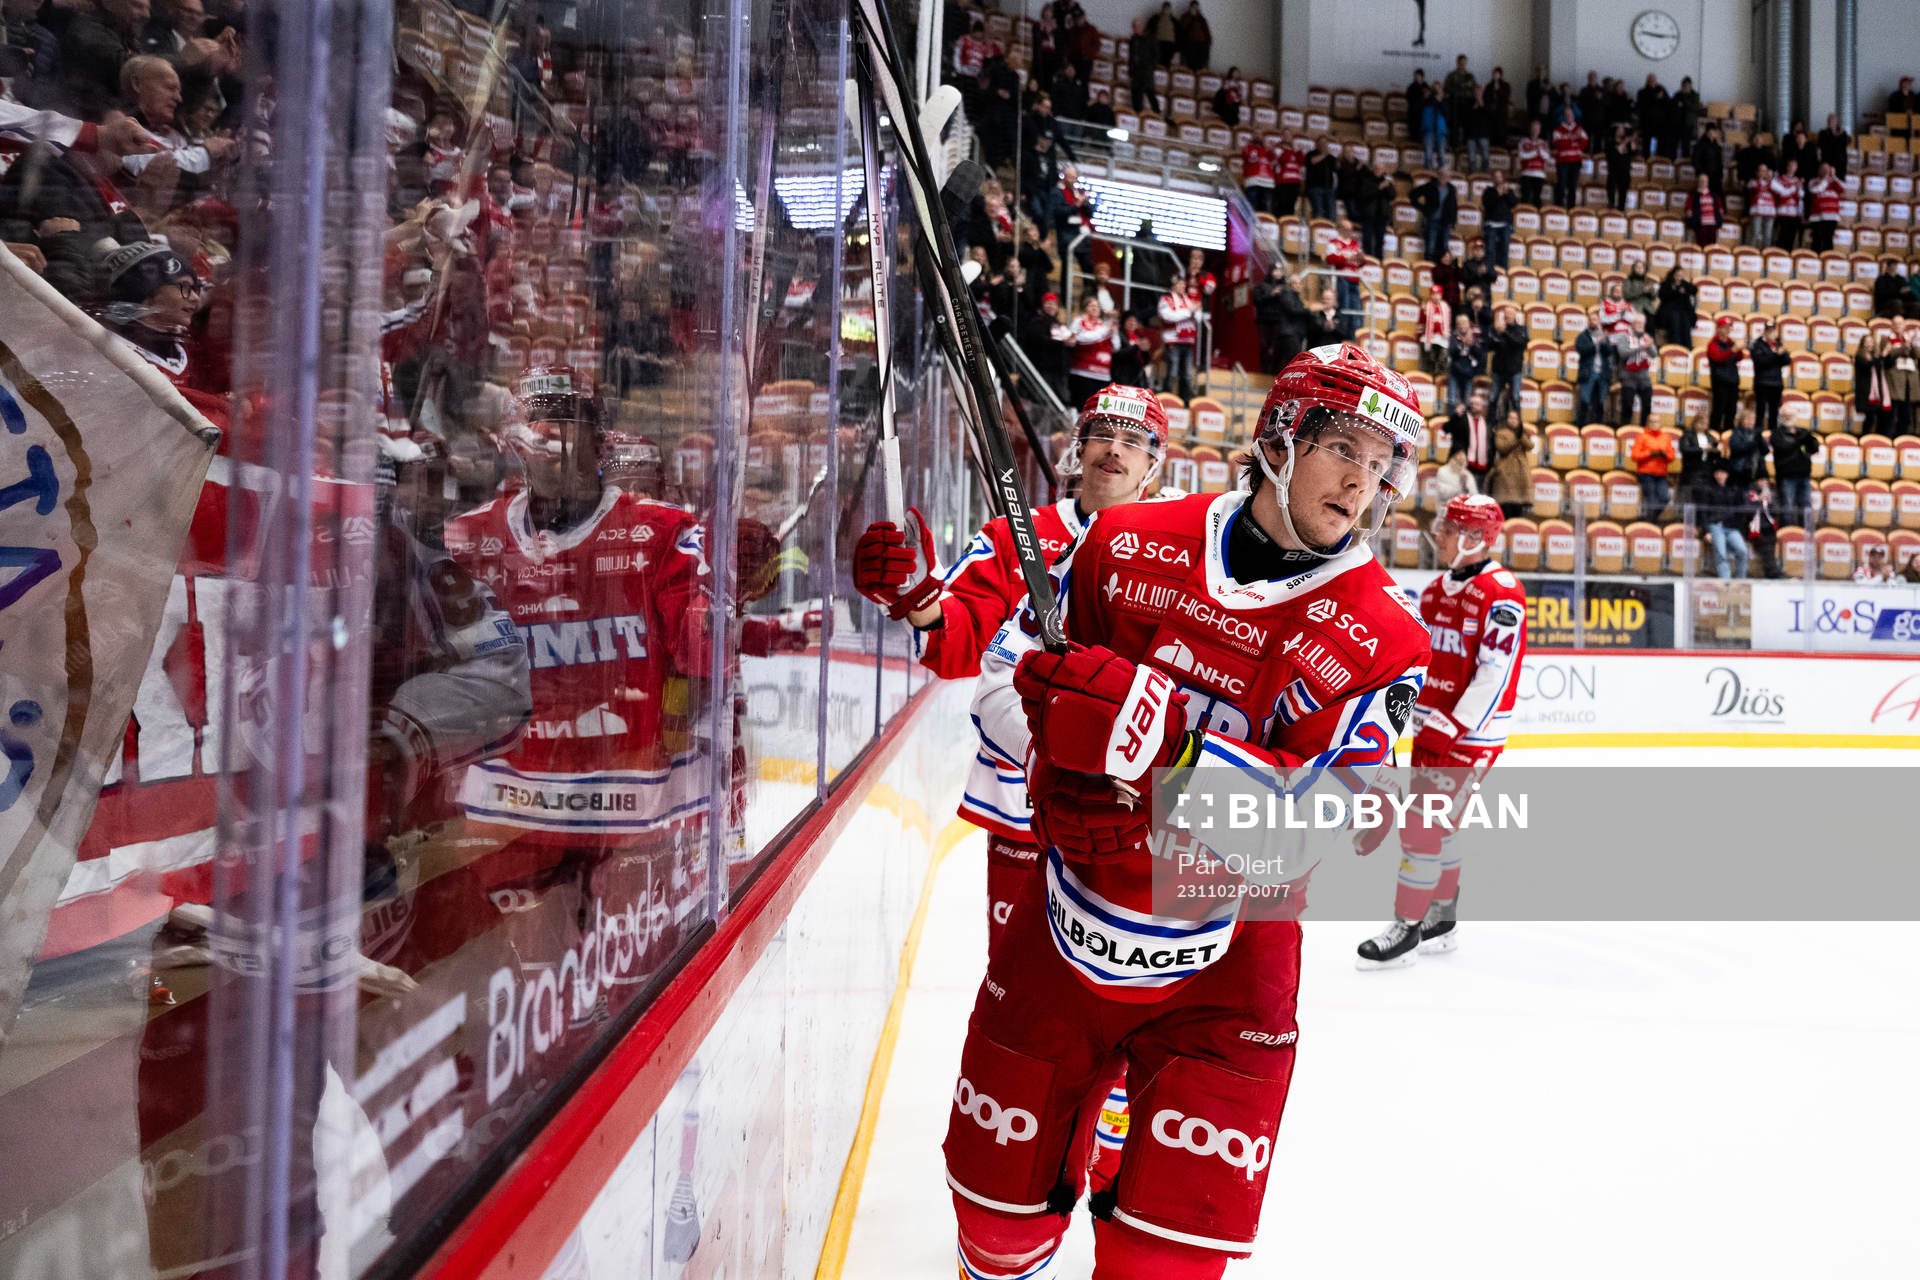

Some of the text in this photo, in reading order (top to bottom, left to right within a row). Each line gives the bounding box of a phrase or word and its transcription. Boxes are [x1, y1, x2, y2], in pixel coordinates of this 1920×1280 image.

[1113, 399, 1145, 416] LILIUM
[1383, 402, 1421, 439] LILIUM
[1002, 486, 1036, 562] BAUER
[1142, 541, 1190, 568] SCA
[1176, 594, 1268, 648] HIGHCON
[1334, 613, 1380, 658] SCA
[1481, 628, 1515, 656] 44
[1193, 661, 1246, 696] NHC
[1298, 639, 1351, 692] LILIUM
[1705, 666, 1785, 717] Diös
[995, 844, 1039, 861] BAUER
[1049, 889, 1218, 970] BILBOLAGET
[1240, 1029, 1298, 1047] BAUER
[1151, 1109, 1270, 1181] coop
